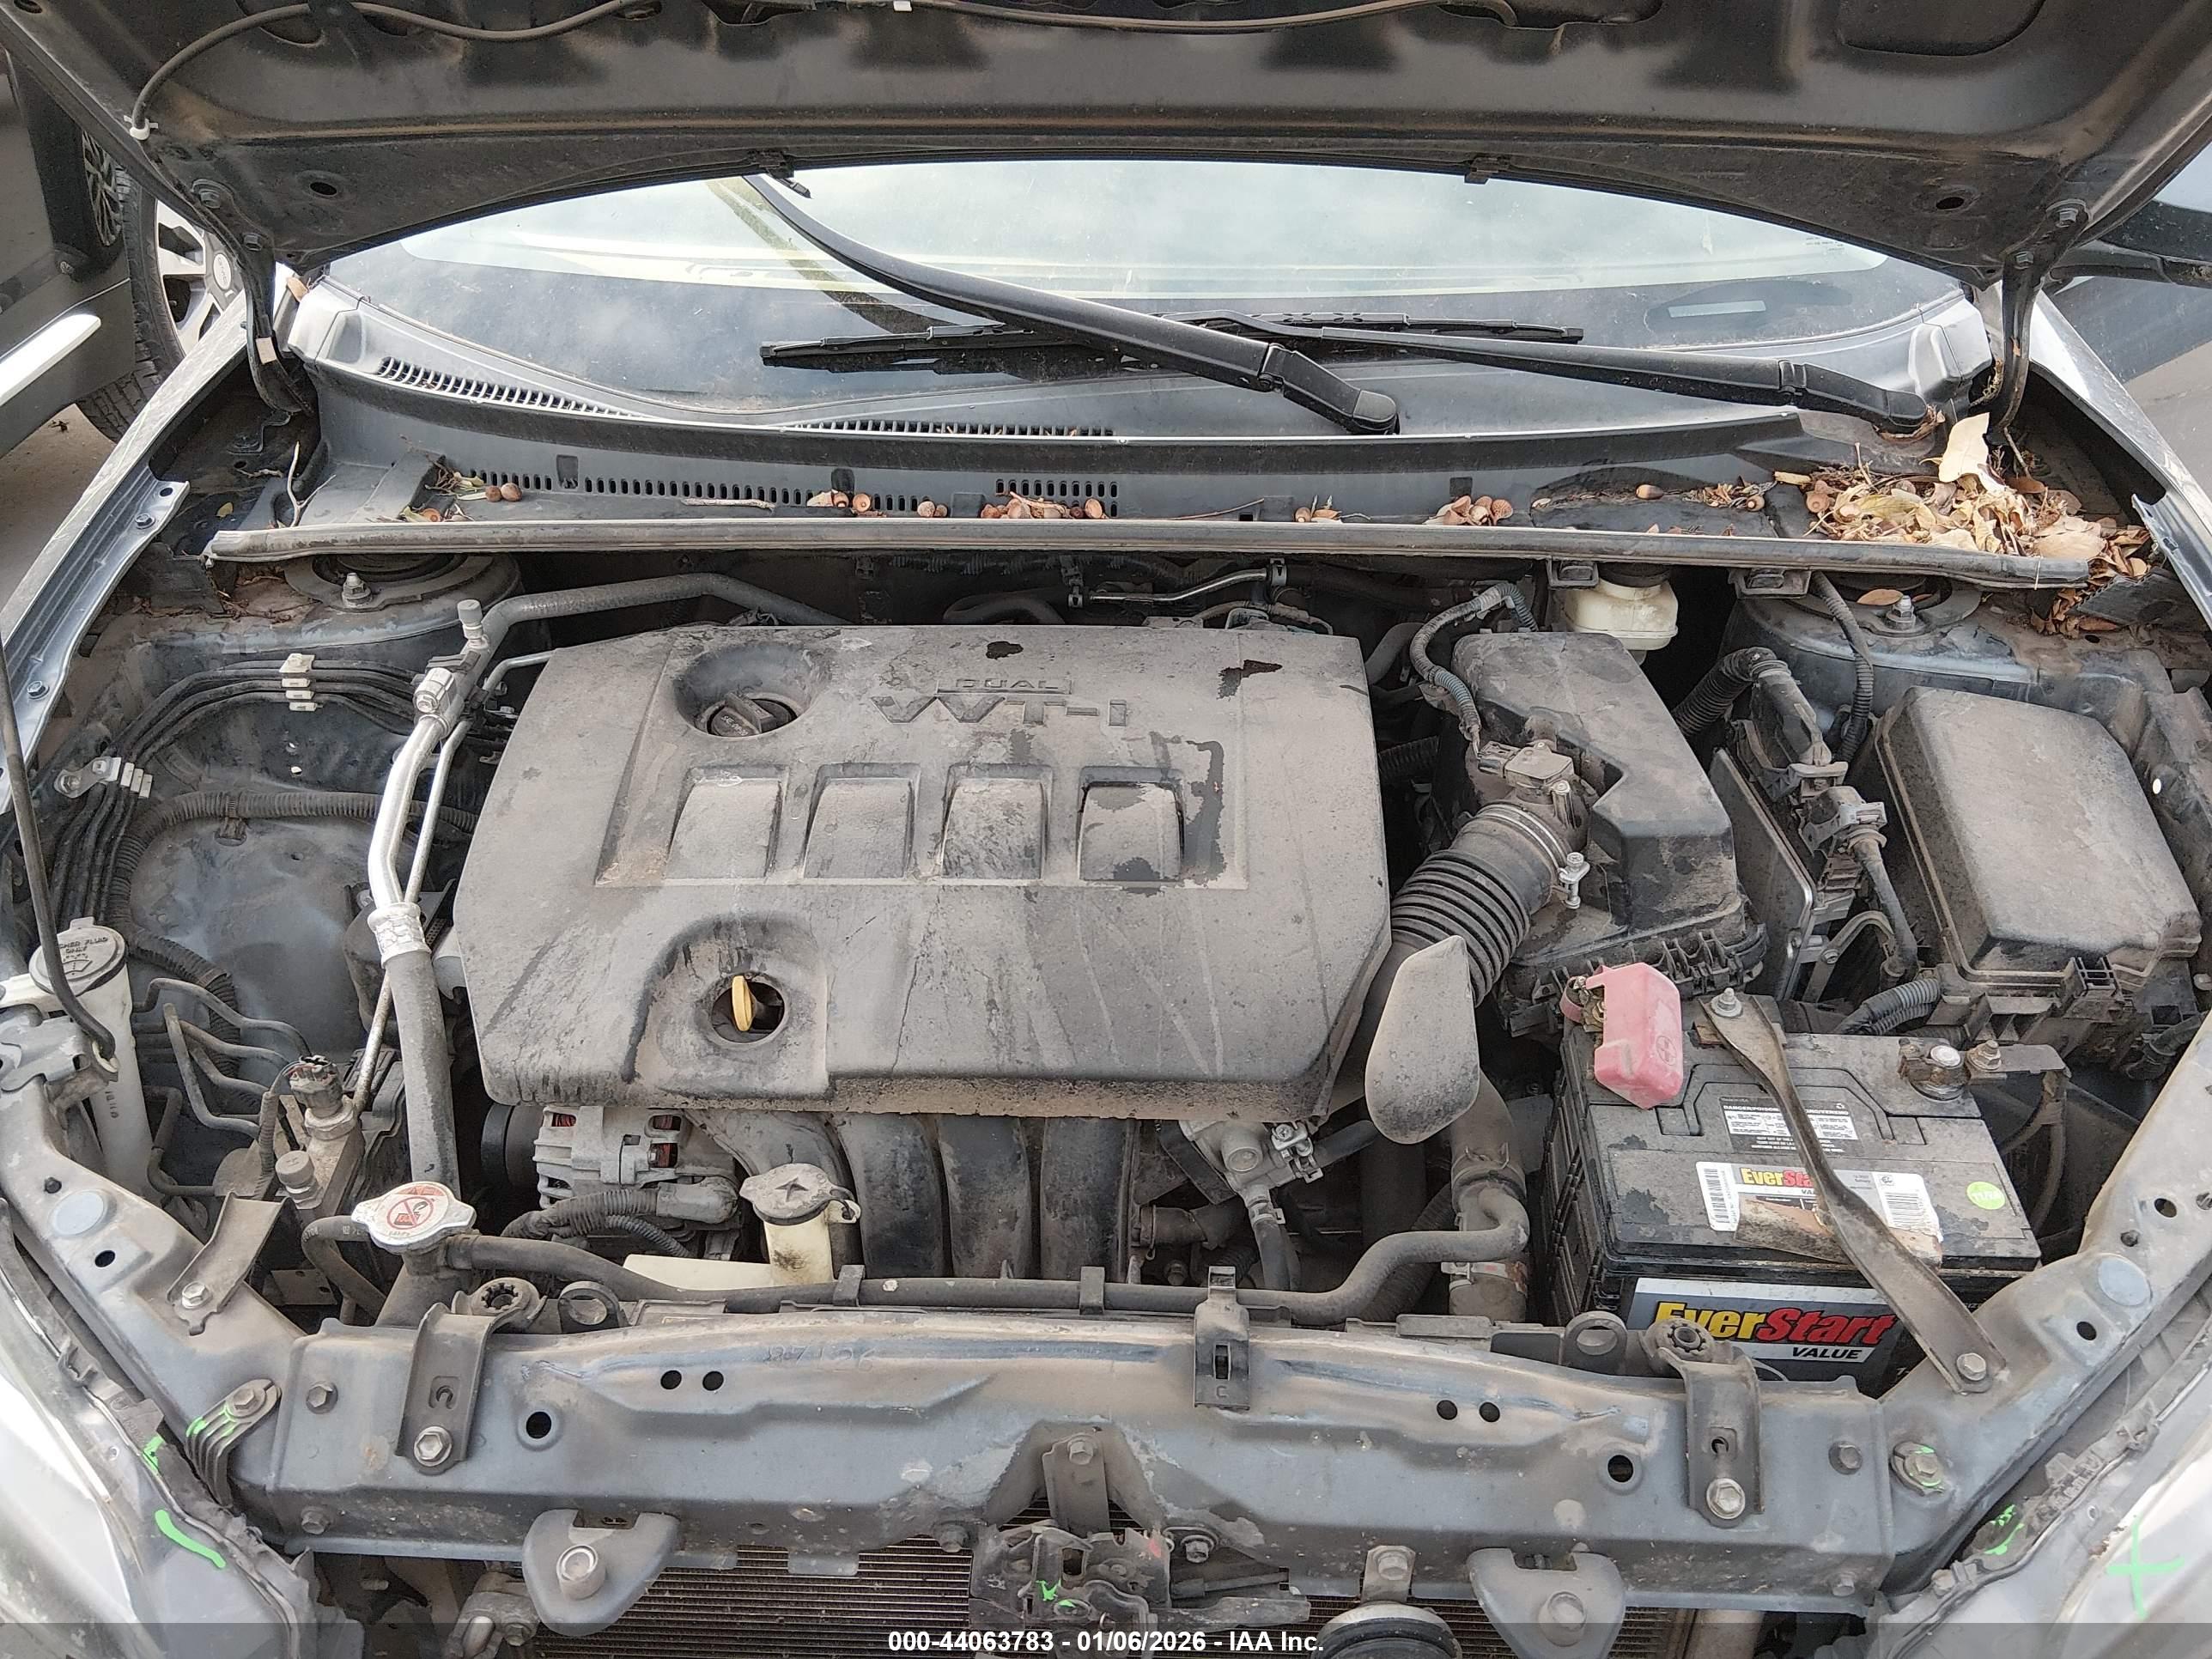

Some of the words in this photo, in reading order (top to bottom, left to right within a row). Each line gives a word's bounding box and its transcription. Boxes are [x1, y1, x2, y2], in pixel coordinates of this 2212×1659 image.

[956, 678, 1059, 690] DUAL
[1740, 1168, 1814, 1187] EverSta
[1792, 1346, 1863, 1359] VALUE
